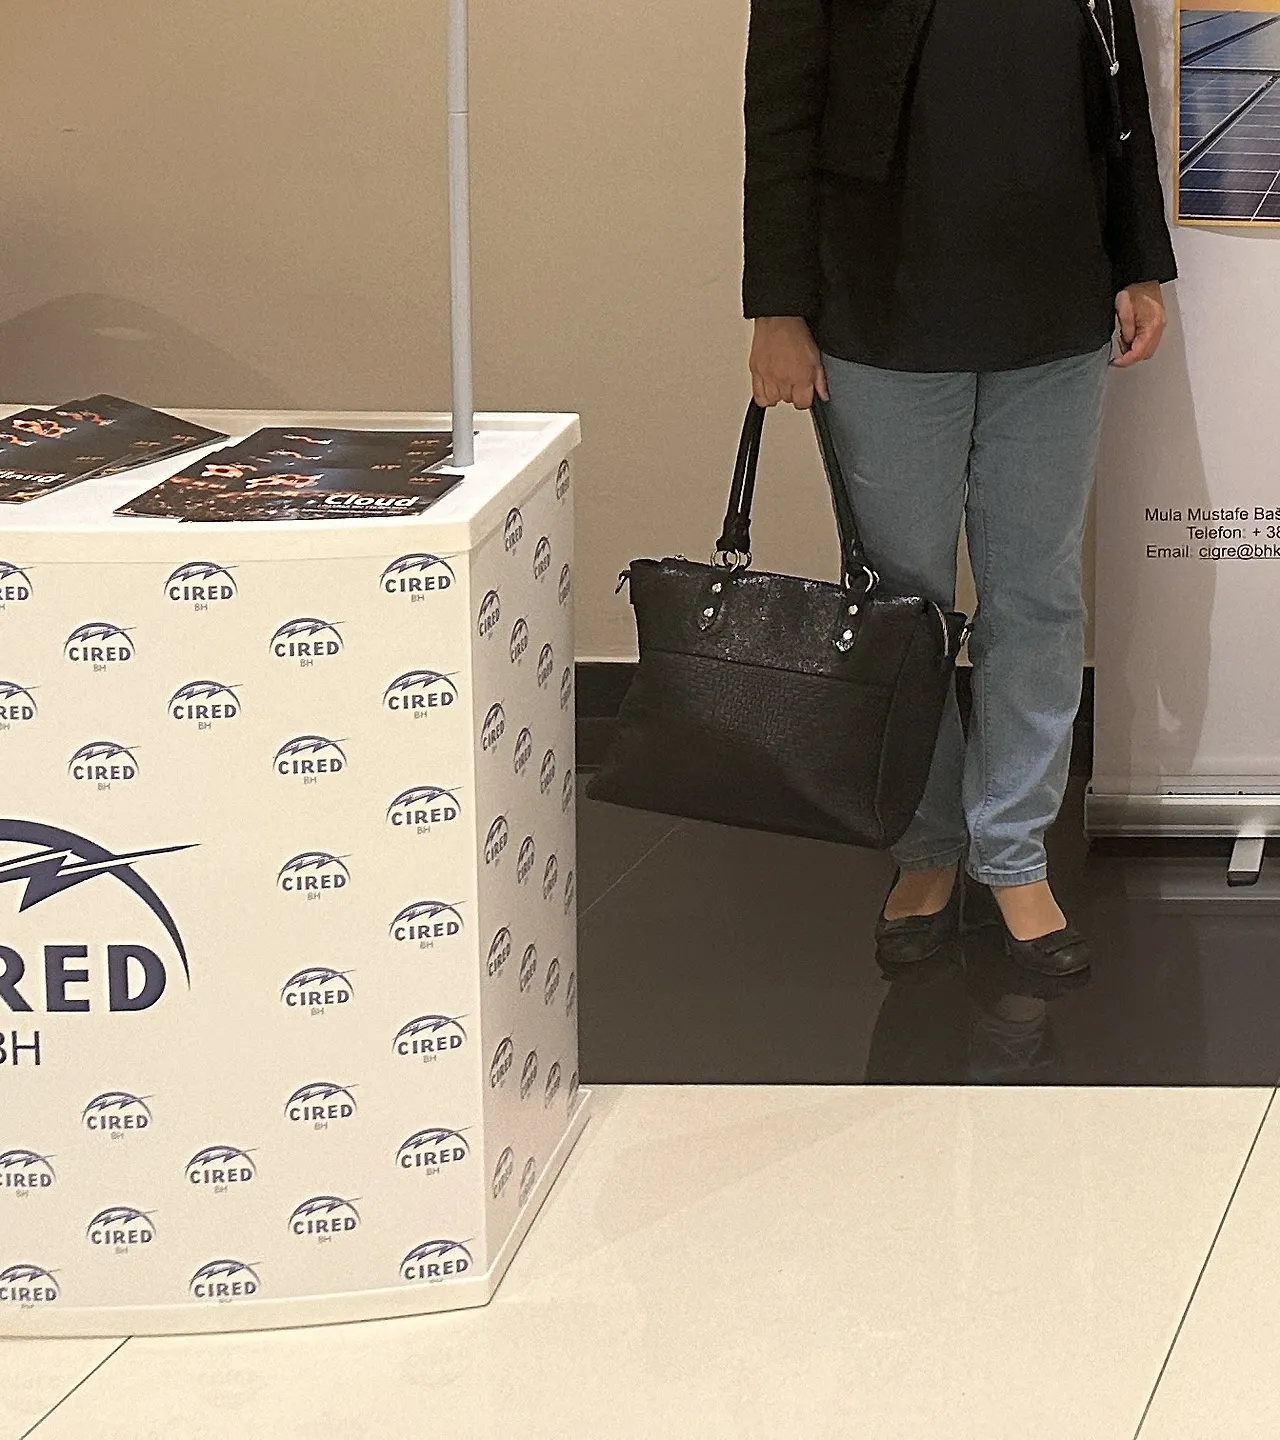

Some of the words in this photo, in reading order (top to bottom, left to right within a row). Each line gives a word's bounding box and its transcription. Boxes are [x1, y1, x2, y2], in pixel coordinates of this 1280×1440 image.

[324, 493, 420, 507] Cloud
[1145, 508, 1182, 522] Mula
[1187, 507, 1249, 522] Mustafe
[1187, 526, 1247, 540] Telefon:
[1146, 545, 1193, 558] Email:
[385, 576, 451, 593] CIRED
[169, 585, 233, 601] CIRED
[479, 608, 500, 637] CIRED
[68, 647, 131, 661] CIRED
[275, 641, 340, 658] CIRED
[388, 692, 454, 710] CIRED
[391, 807, 457, 827] CIRED
[86, 1114, 149, 1130] CIRED
[293, 1217, 357, 1235] CIRED
[404, 1258, 469, 1281] CIRED
